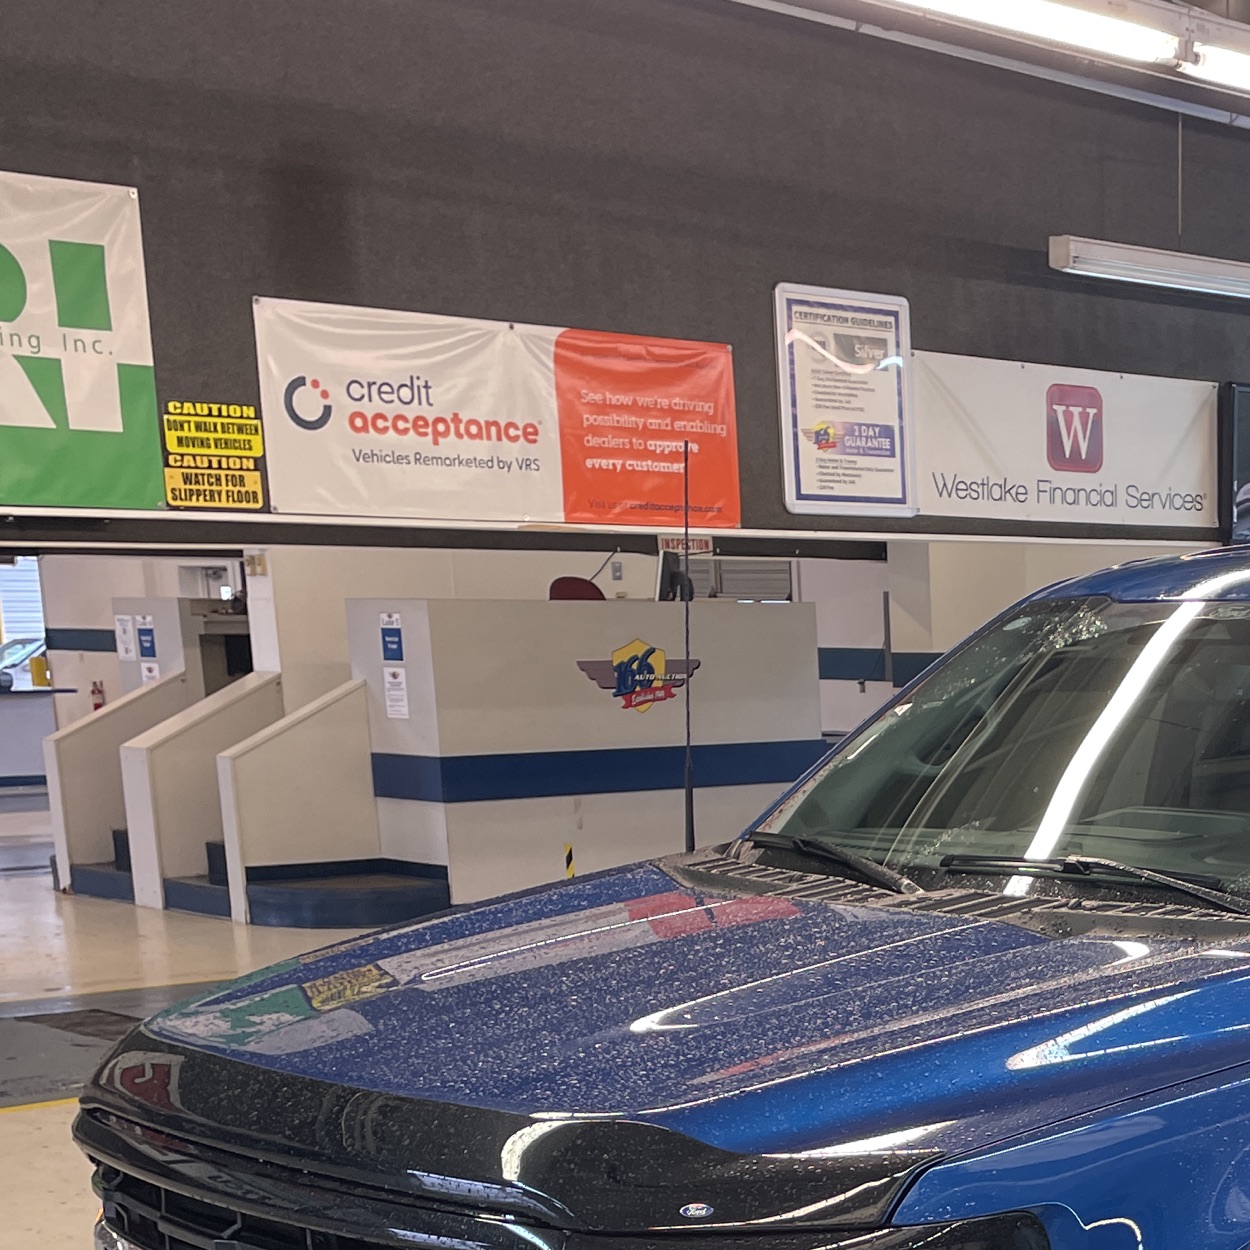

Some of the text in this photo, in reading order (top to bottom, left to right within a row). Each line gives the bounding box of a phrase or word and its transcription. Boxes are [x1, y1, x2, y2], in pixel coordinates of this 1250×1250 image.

[794, 310, 893, 329] CERTIFICATION GUIDELINES
[63, 333, 113, 355] Inc.
[854, 344, 885, 359] Silver
[345, 375, 434, 407] credit
[167, 401, 255, 418] CAUTION
[580, 389, 715, 415] See how we're driving
[166, 418, 260, 436] DON'T WALK BETWEEN
[348, 411, 540, 446] acceptance
[583, 413, 727, 437] possibility and enabling
[853, 425, 881, 437] 3 DAY
[1052, 404, 1098, 460] W
[176, 435, 253, 451] MOVING VEHICLES
[584, 434, 630, 449] dealers
[632, 437, 645, 450] to
[844, 436, 891, 449] GUARANTEE
[168, 454, 255, 470] CAUTION
[352, 448, 541, 473] Vehicles Remarketed by VRS
[585, 457, 623, 472] every
[181, 472, 246, 488] WATCH FOR
[170, 487, 259, 504] SLIPPERY FLOOR
[932, 472, 1204, 512] Westlake Financial Services
[629, 501, 722, 513] creditacceptnce.com
[661, 538, 709, 550] INSPECTION
[612, 647, 656, 697] 166
